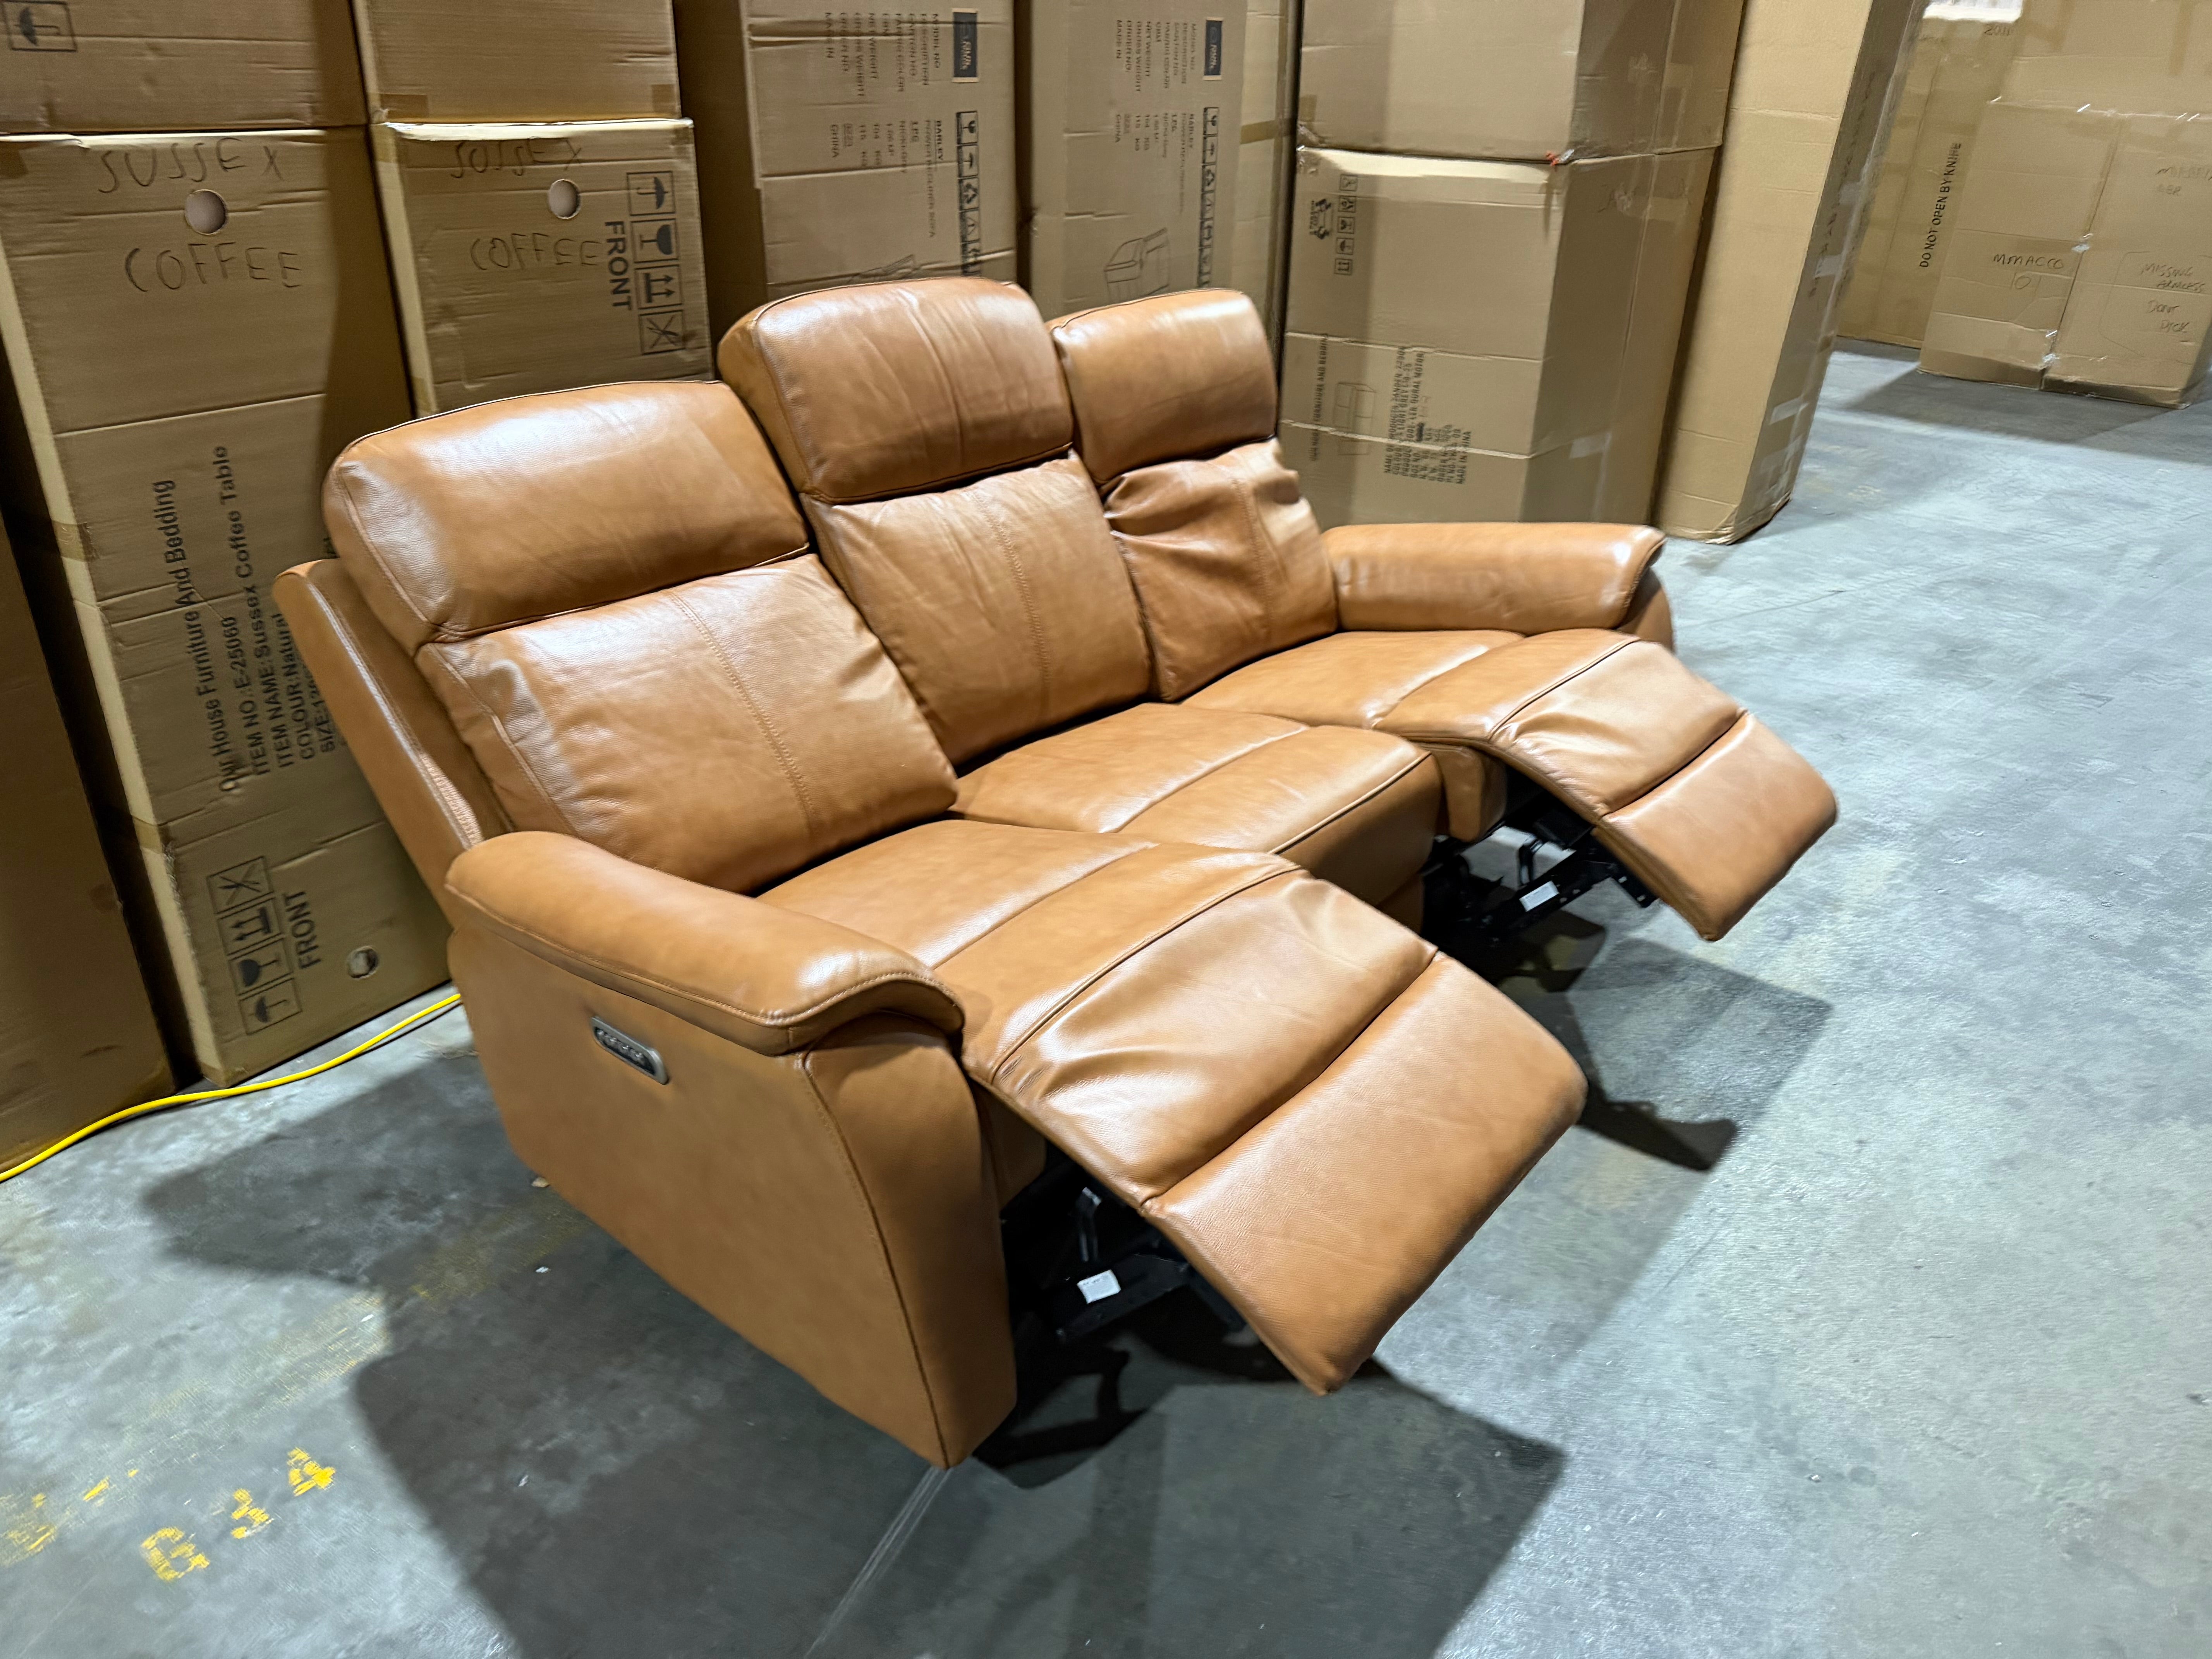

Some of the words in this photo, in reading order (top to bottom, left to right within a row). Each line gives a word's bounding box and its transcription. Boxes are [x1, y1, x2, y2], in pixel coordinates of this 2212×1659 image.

[98, 137, 285, 193] SUSSEX
[1944, 143, 1961, 175] KNIFE
[1939, 179, 1953, 193] BY
[1932, 196, 1948, 226] OPEN
[470, 232, 602, 271] COFFEE
[1919, 252, 1932, 268] DO
[1924, 229, 1939, 250] NOT
[125, 241, 301, 292] COFFEE
[605, 221, 631, 311] FRONT
[213, 446, 236, 506] Table
[152, 479, 187, 565] Bedding
[228, 510, 253, 579] Coffee
[168, 567, 193, 606] And
[183, 611, 218, 697] Furniture
[204, 699, 229, 757] House
[269, 723, 295, 768] ITEM
[245, 731, 270, 775] ITEM
[283, 891, 321, 970] FRONT
